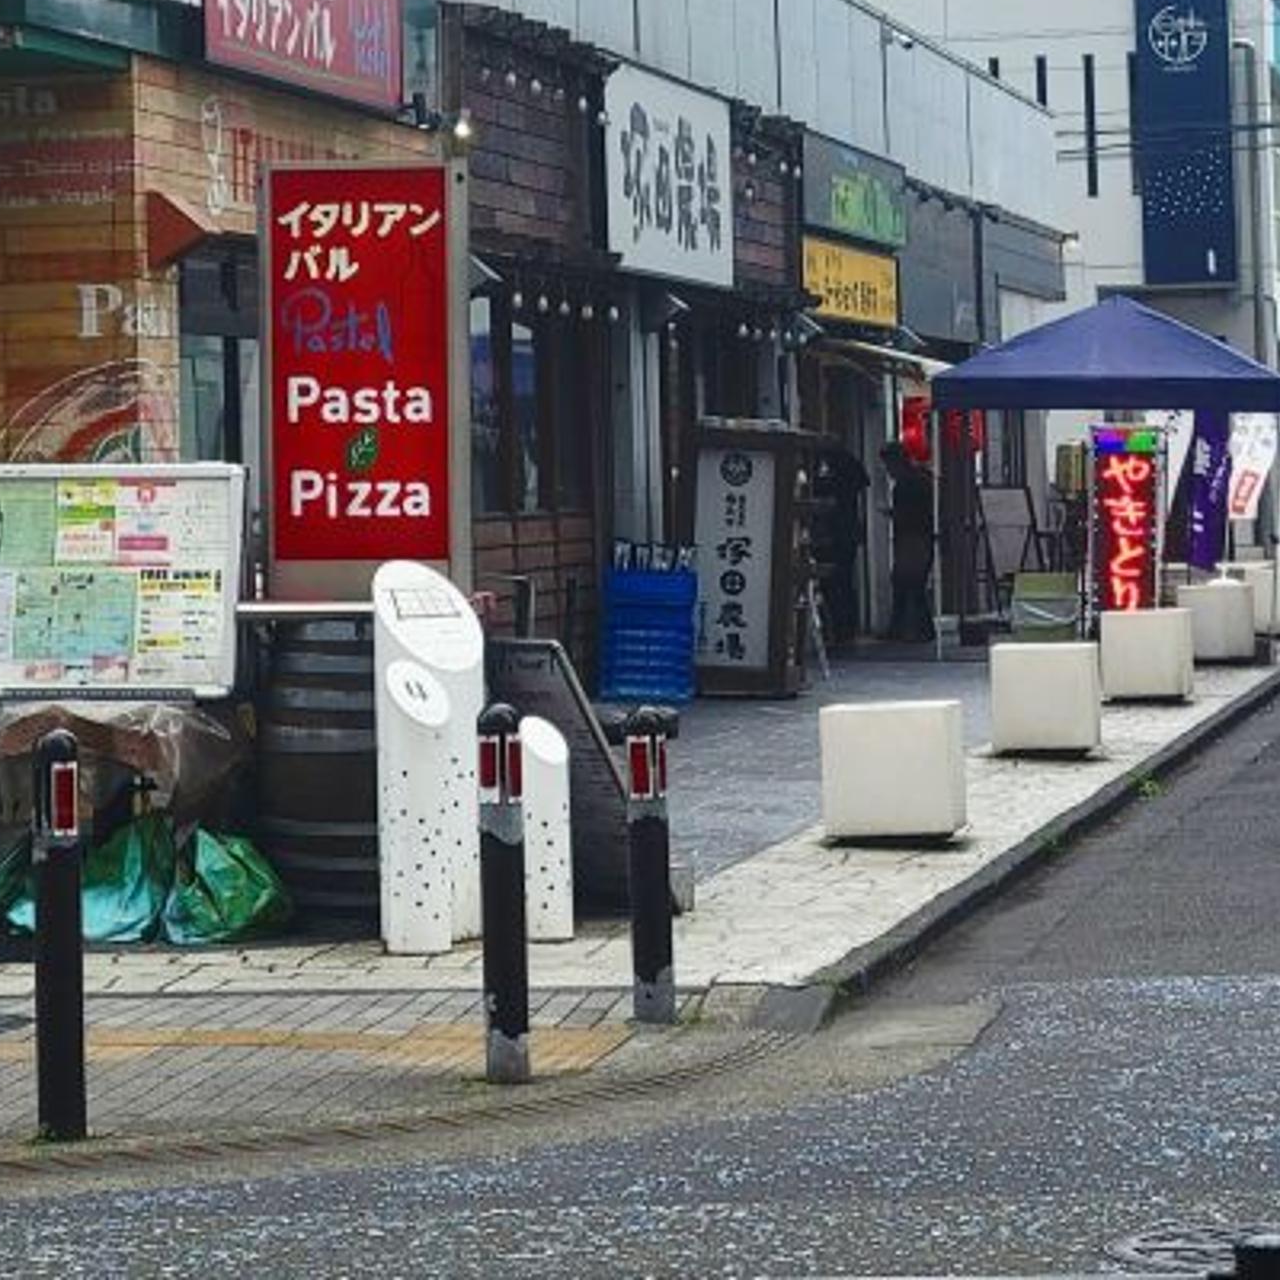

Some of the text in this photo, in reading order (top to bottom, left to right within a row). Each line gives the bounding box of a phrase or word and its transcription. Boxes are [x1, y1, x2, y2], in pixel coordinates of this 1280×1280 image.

[277, 201, 441, 239] イタリアン
[284, 246, 359, 282] バル
[281, 285, 395, 360] Pastel
[287, 376, 433, 424] Pasta
[289, 470, 431, 518] Pizza
[1102, 455, 1151, 612] やきとり
